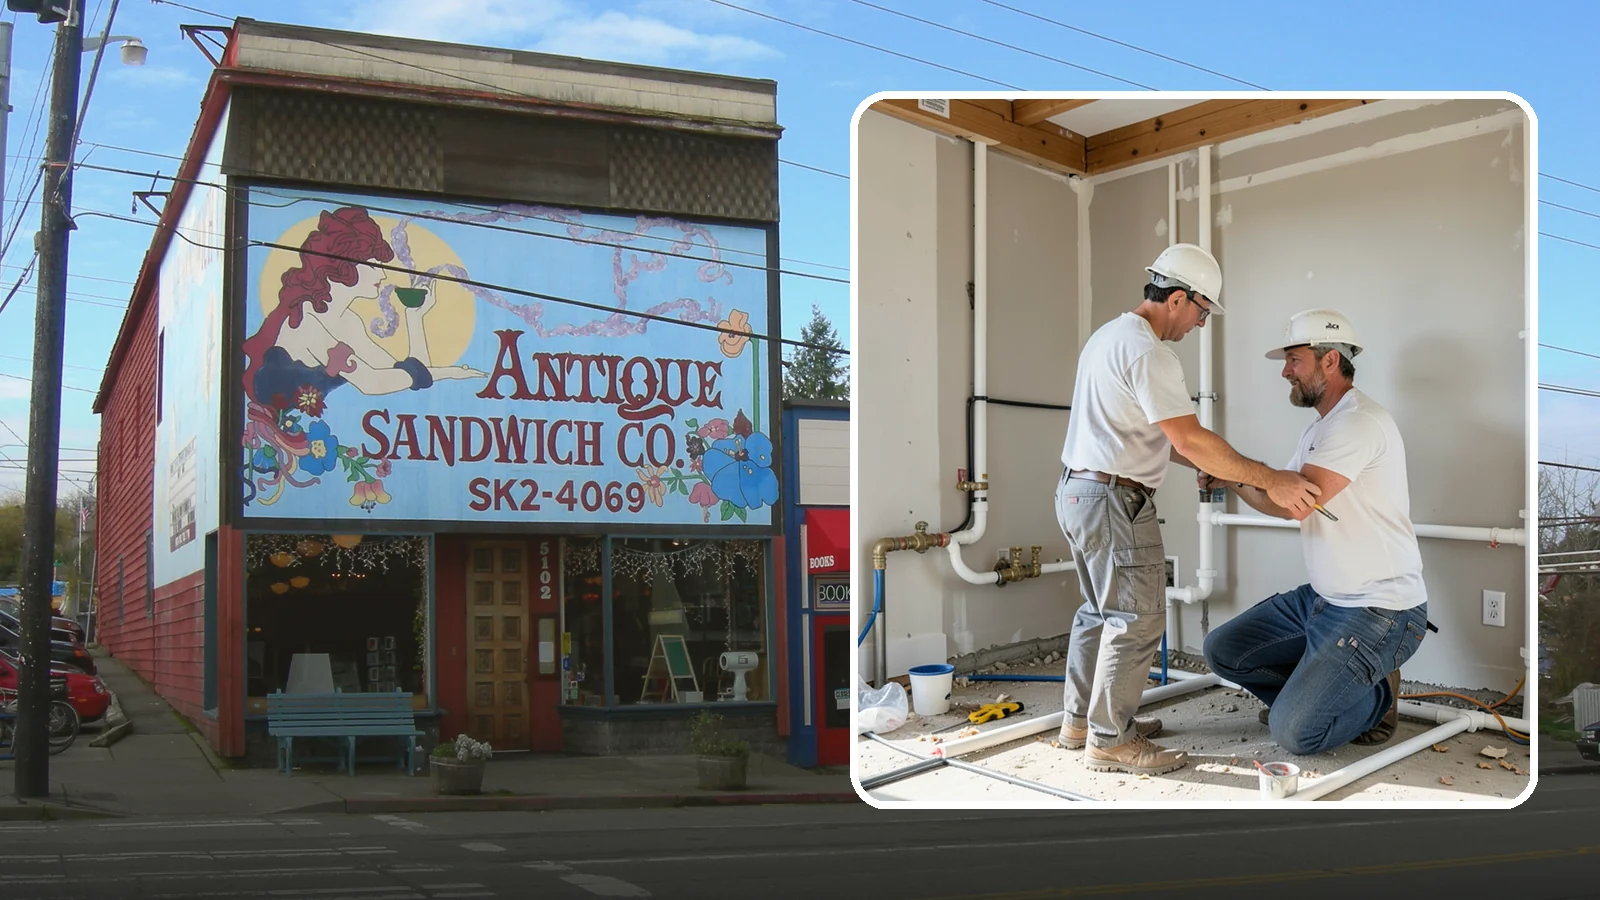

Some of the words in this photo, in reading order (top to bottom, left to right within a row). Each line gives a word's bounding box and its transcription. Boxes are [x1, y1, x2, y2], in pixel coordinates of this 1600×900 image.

[475, 329, 723, 421] ANTIQUE
[361, 408, 604, 468] SANDWICH
[616, 421, 685, 468] CO.
[468, 477, 645, 513] SK2-4069
[539, 542, 551, 600] 5102
[809, 555, 835, 568] BOOKS
